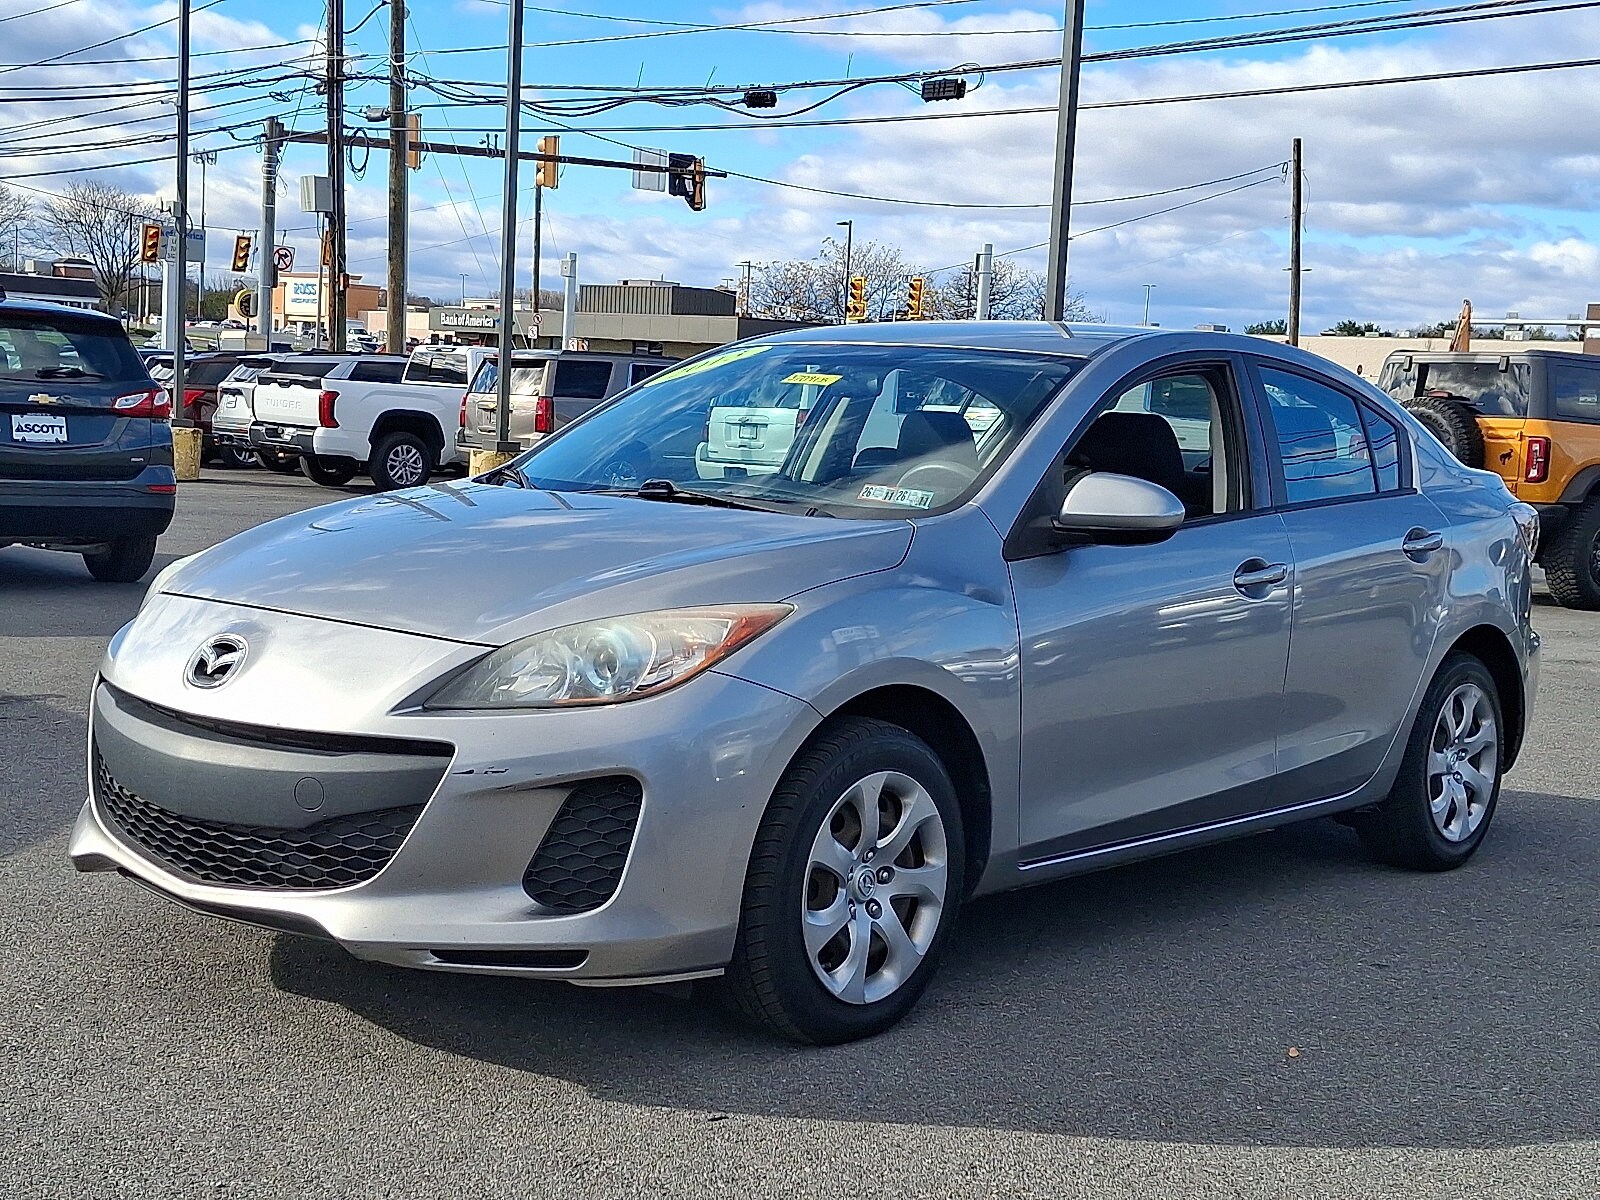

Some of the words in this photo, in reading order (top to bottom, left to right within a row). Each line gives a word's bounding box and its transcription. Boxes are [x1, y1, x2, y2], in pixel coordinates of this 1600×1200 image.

[440, 312, 458, 326] Bank
[458, 313, 466, 326] of
[465, 313, 494, 327] America
[861, 486, 874, 498] 26
[883, 491, 895, 501] 11
[896, 490, 909, 502] 26
[918, 496, 929, 507] 11
